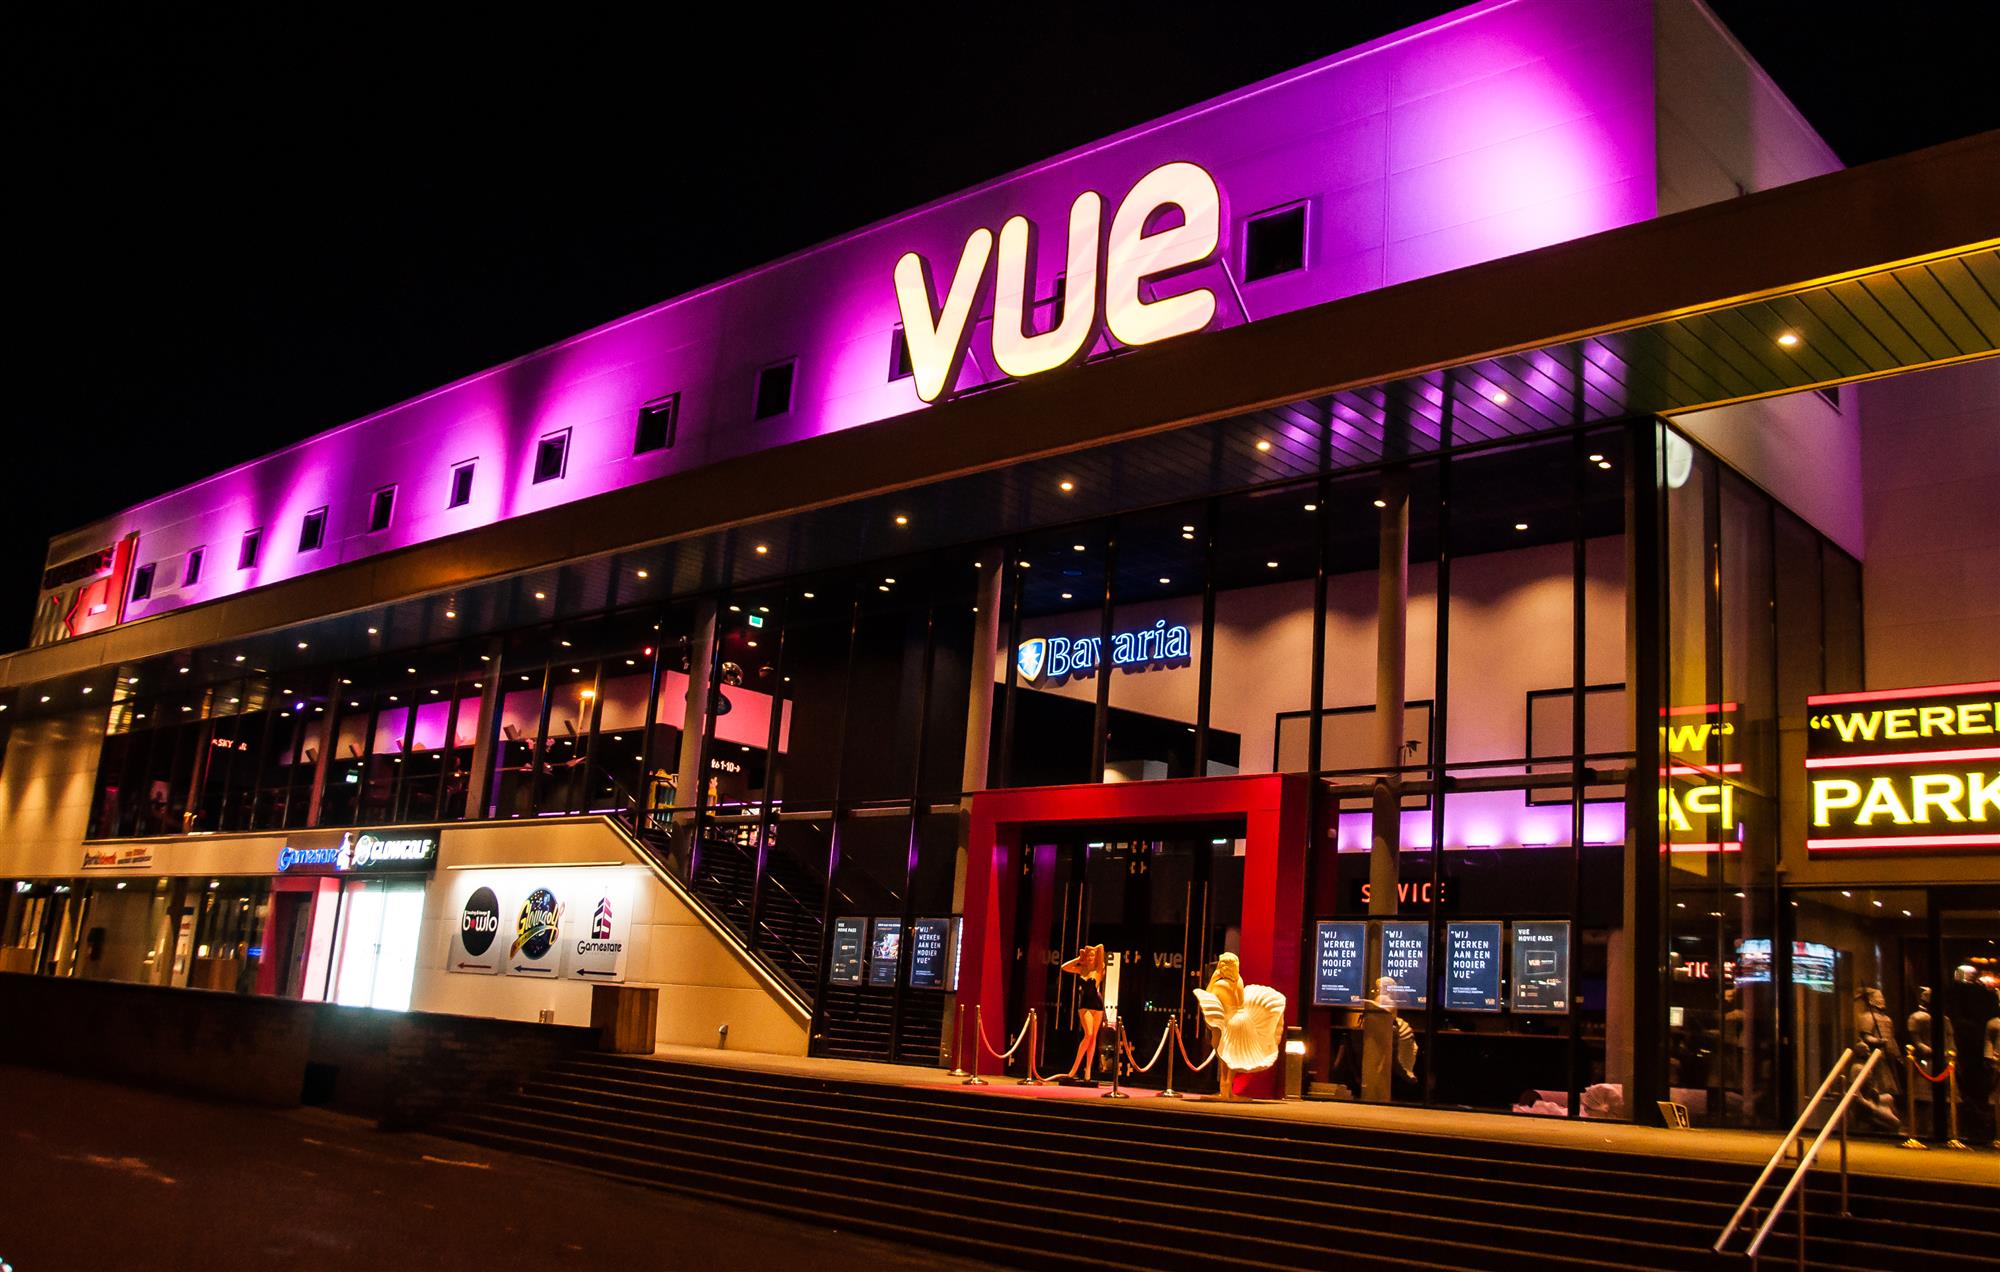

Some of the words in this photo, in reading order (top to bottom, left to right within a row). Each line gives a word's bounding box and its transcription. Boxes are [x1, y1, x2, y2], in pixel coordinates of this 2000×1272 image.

[893, 160, 1221, 403] vue
[1810, 701, 2000, 743] “WERE
[1812, 772, 2000, 827] PARK
[1361, 883, 1446, 903] SVIC
[577, 940, 622, 954] Gamestate
[1323, 940, 1355, 948] WERKEN
[1388, 940, 1422, 948] WERKEN
[1454, 940, 1489, 949] WERKEN
[1323, 950, 1339, 958] AAN
[1341, 950, 1356, 958] EEN
[1388, 950, 1405, 958] AAN
[1407, 950, 1423, 958] EEN
[1453, 951, 1472, 959] AAN
[1474, 951, 1490, 959] EEN
[1322, 959, 1352, 967] MOOIER
[1387, 959, 1419, 968] MOOIER
[1453, 960, 1486, 969] MOOIER
